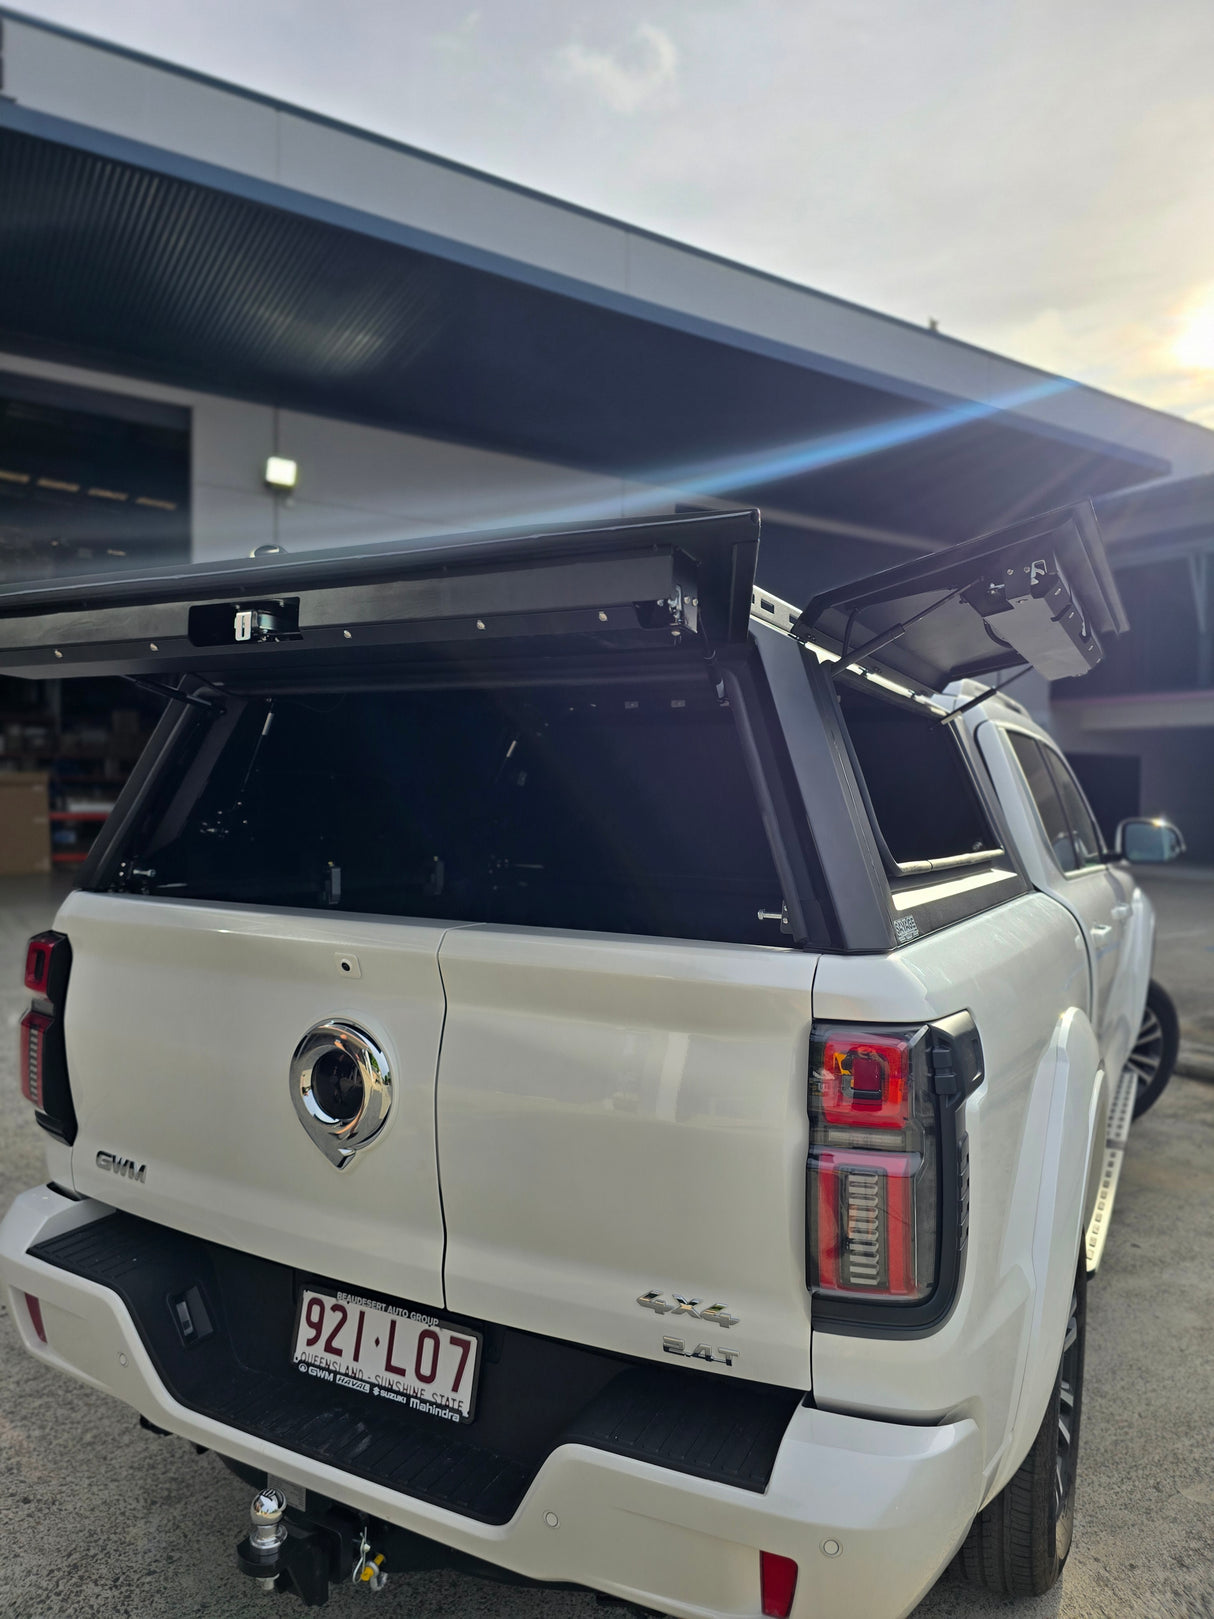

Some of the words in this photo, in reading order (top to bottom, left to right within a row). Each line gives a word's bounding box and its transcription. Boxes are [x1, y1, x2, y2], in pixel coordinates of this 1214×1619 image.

[95, 1149, 147, 1185] GWM
[336, 1291, 387, 1313] BEAUDESERT
[387, 1304, 409, 1319] AUTO
[409, 1311, 440, 1327] GROUP
[662, 1335, 740, 1367] 2.4T
[300, 1351, 364, 1381] QUEENSLAND
[374, 1374, 426, 1399] SUNSHINE
[431, 1392, 464, 1411] STATE
[308, 1365, 335, 1382] GWM
[337, 1376, 370, 1393] HAVAL
[380, 1389, 407, 1404] SUZUKI
[409, 1397, 460, 1422] Mahindra
